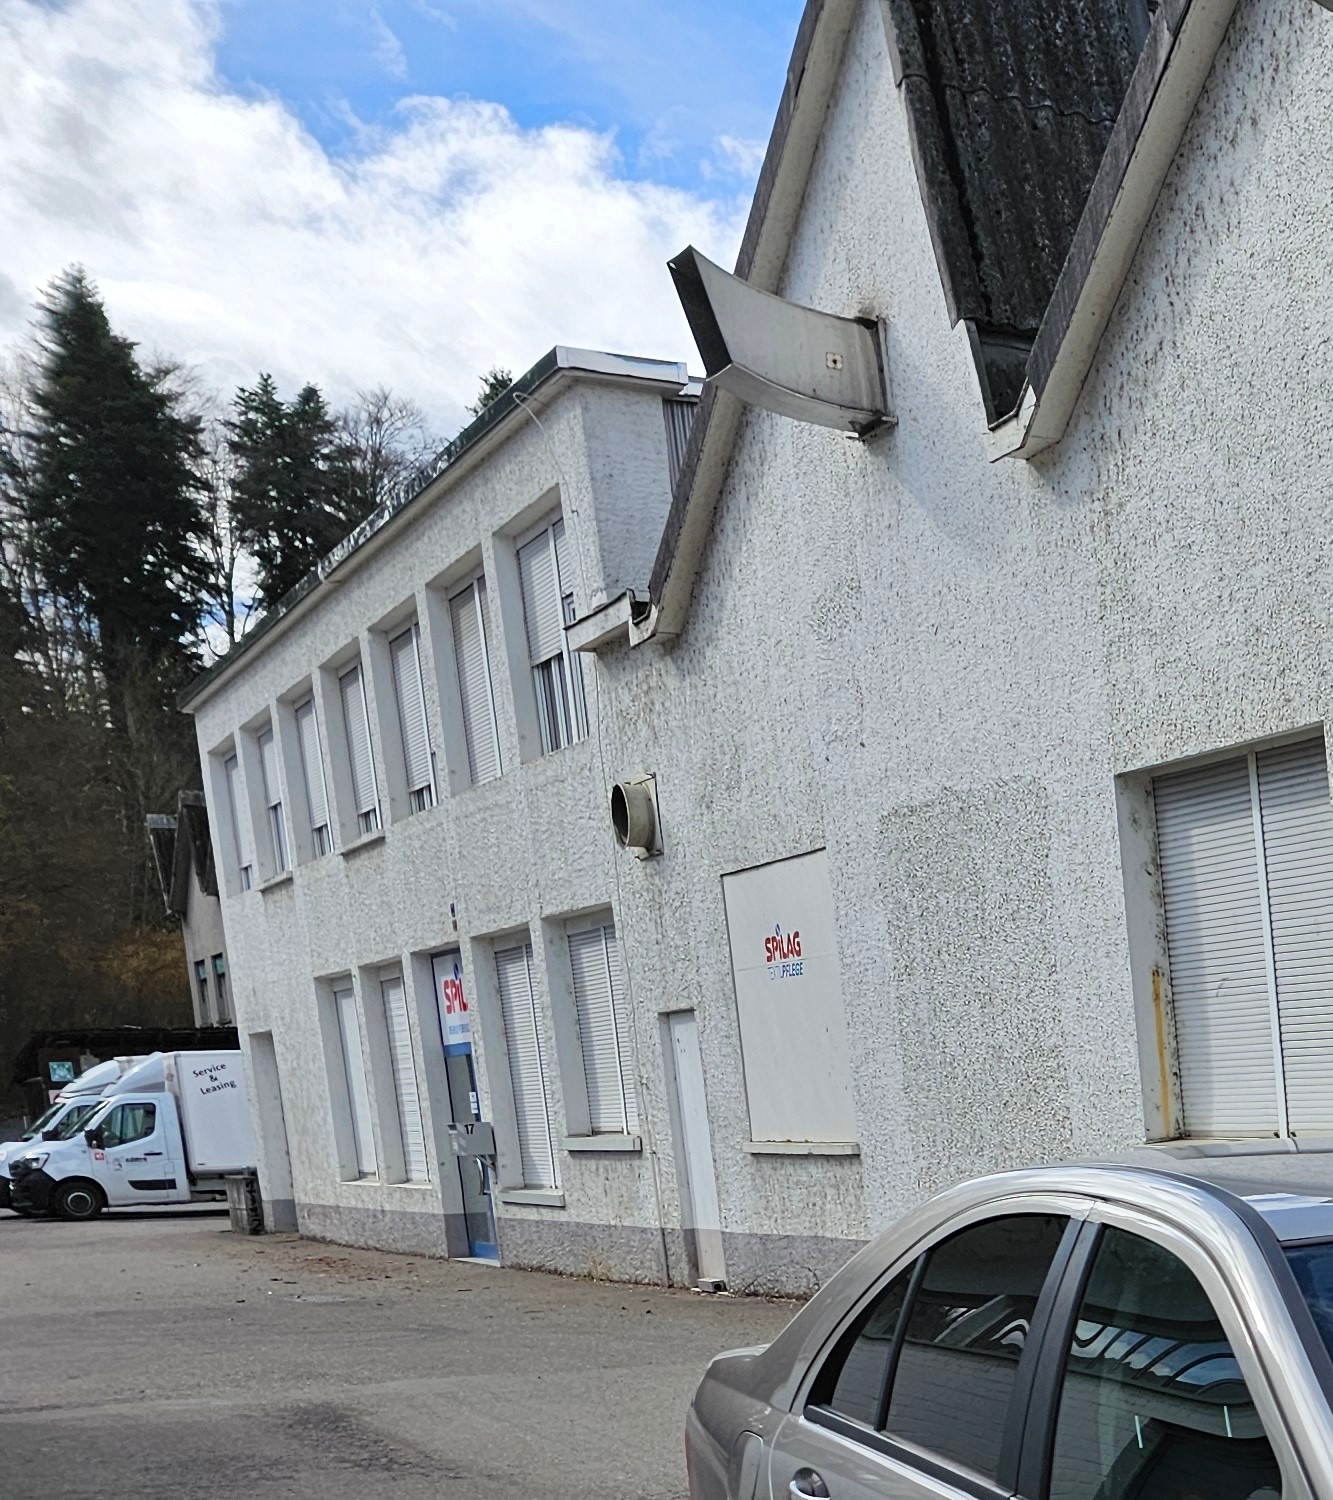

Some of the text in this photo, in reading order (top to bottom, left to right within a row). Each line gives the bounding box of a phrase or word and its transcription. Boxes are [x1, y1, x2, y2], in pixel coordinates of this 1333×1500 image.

[192, 1063, 226, 1078] Service
[208, 1074, 218, 1082] &
[200, 1080, 237, 1095] Leasing
[464, 1123, 474, 1135] 17
